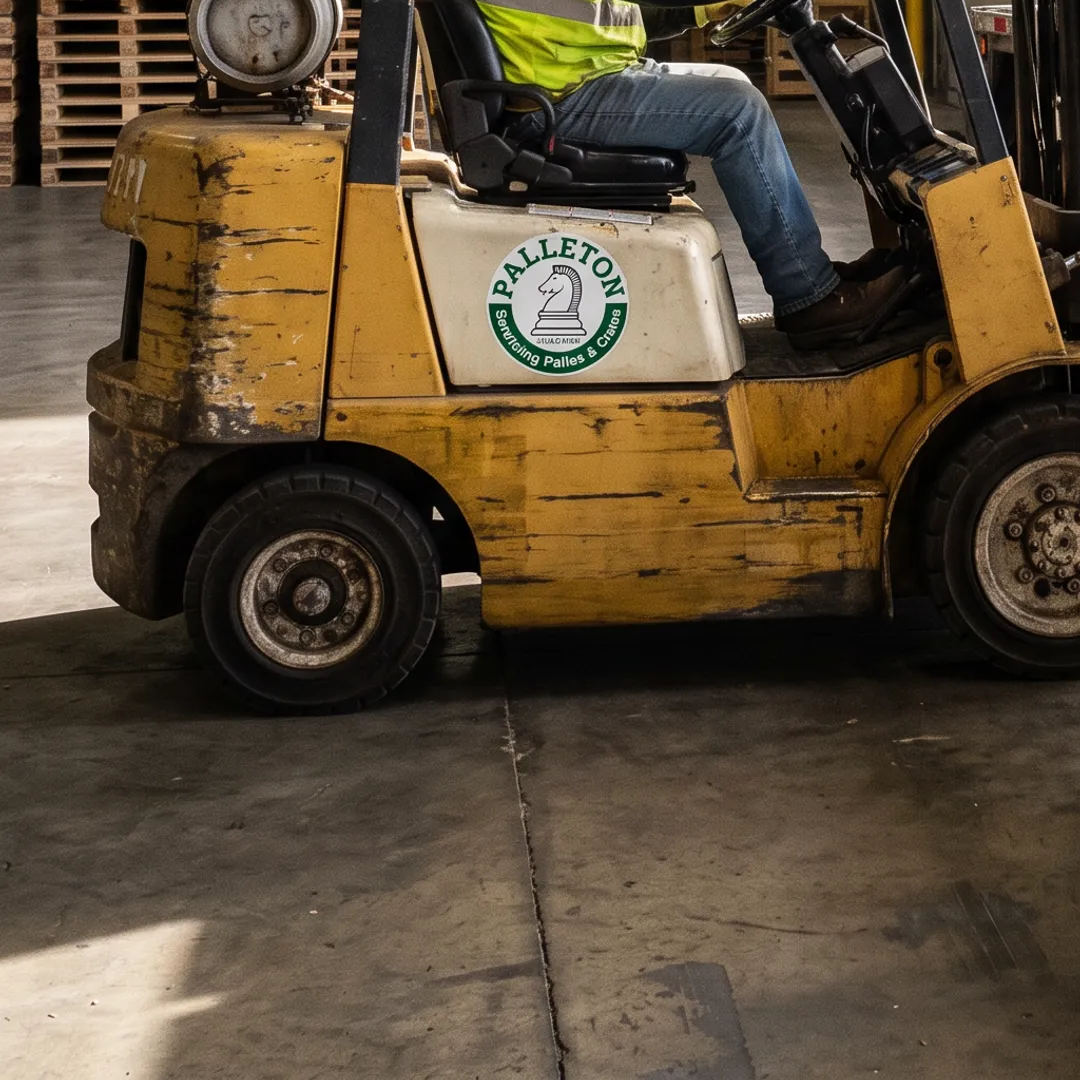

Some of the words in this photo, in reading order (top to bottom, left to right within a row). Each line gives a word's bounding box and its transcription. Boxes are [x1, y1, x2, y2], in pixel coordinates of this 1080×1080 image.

[492, 237, 626, 300] PALLETON
[543, 354, 586, 368] Palles
[586, 346, 598, 358] &
